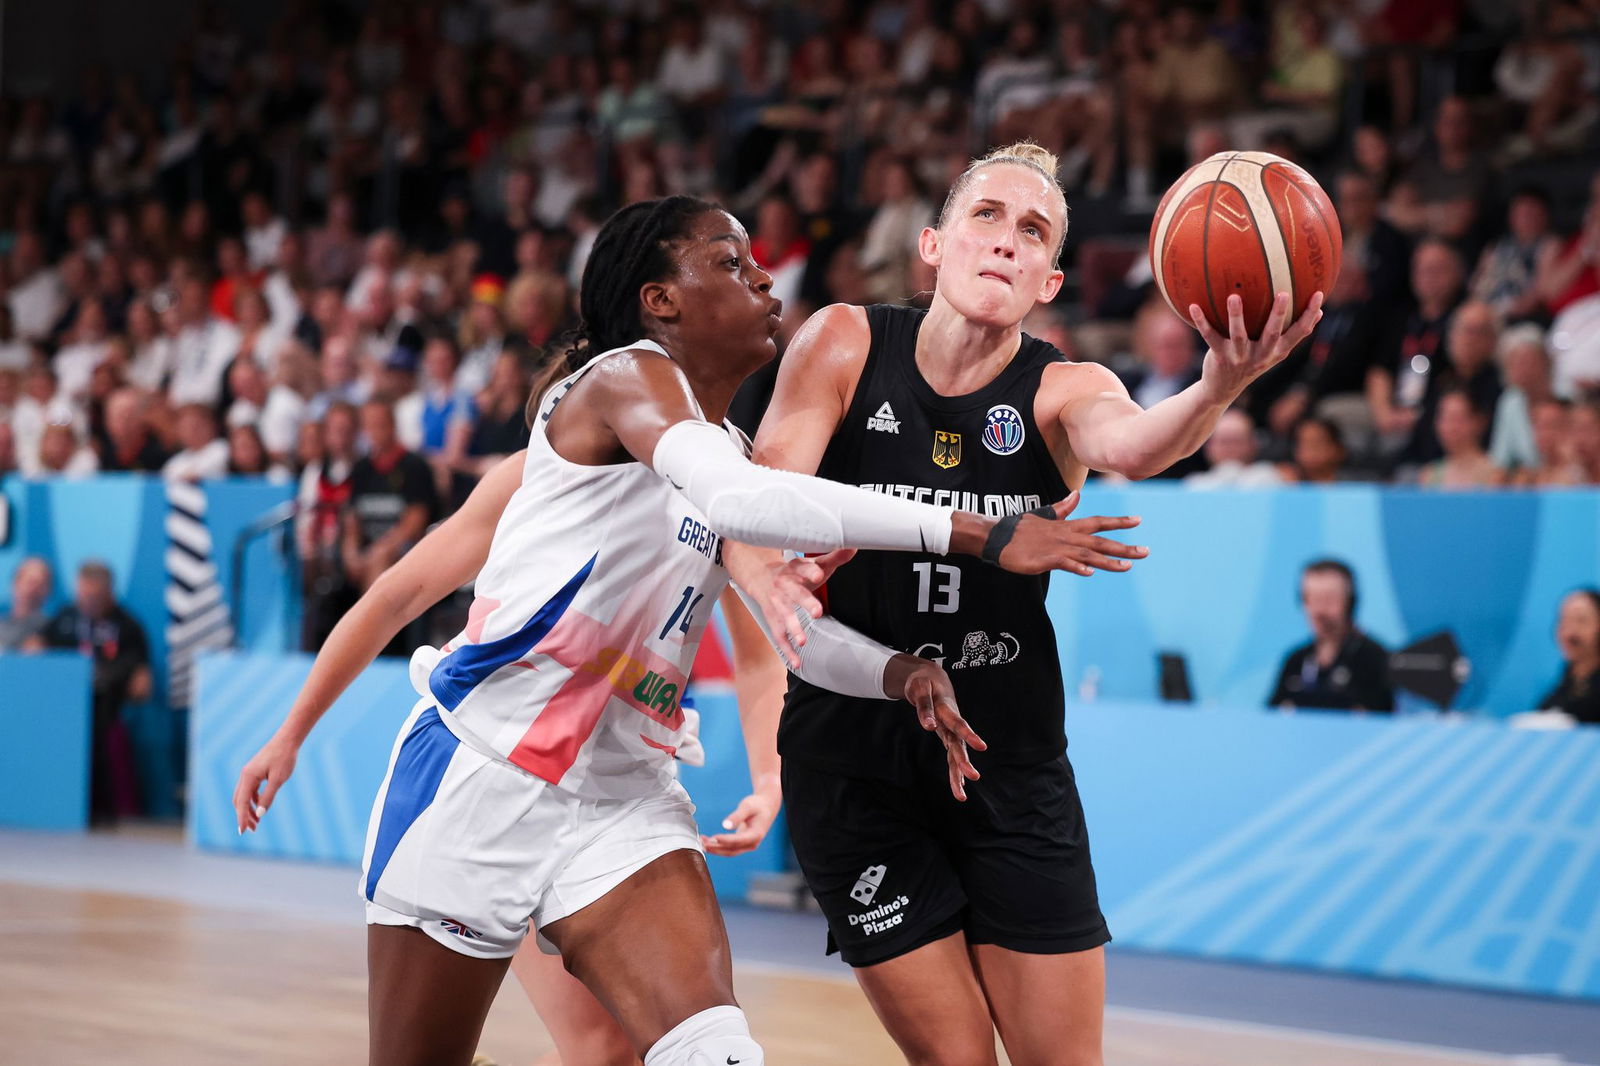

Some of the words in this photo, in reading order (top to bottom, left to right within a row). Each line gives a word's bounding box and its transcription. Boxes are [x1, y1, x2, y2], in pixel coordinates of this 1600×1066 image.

[866, 416, 902, 435] PEAK
[677, 516, 717, 559] GREAT
[913, 562, 962, 614] 13
[847, 895, 909, 926] Domino's
[862, 912, 904, 936] Pizza
